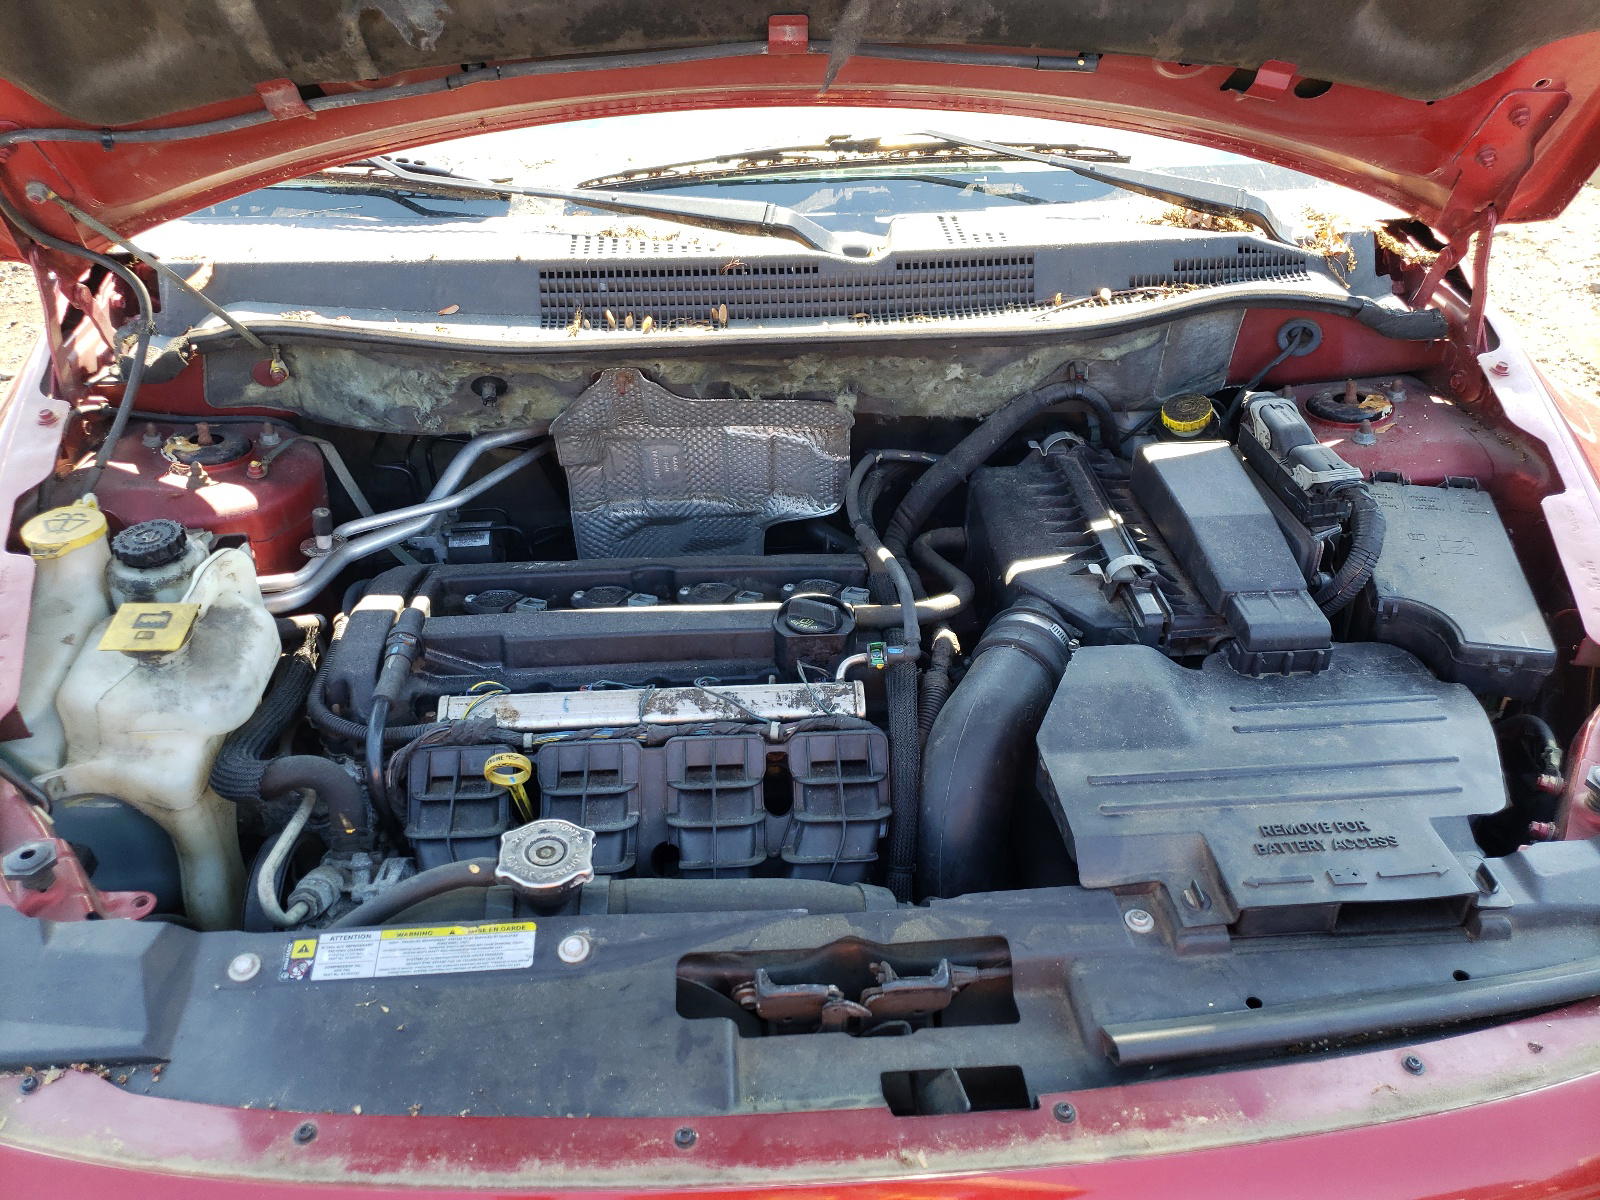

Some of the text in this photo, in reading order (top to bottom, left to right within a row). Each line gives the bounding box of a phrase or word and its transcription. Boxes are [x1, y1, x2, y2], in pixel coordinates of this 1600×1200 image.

[1258, 821, 1372, 838] REMOVE FOR
[1254, 835, 1400, 856] BATTERY ACCESS
[396, 930, 433, 938] WARNING
